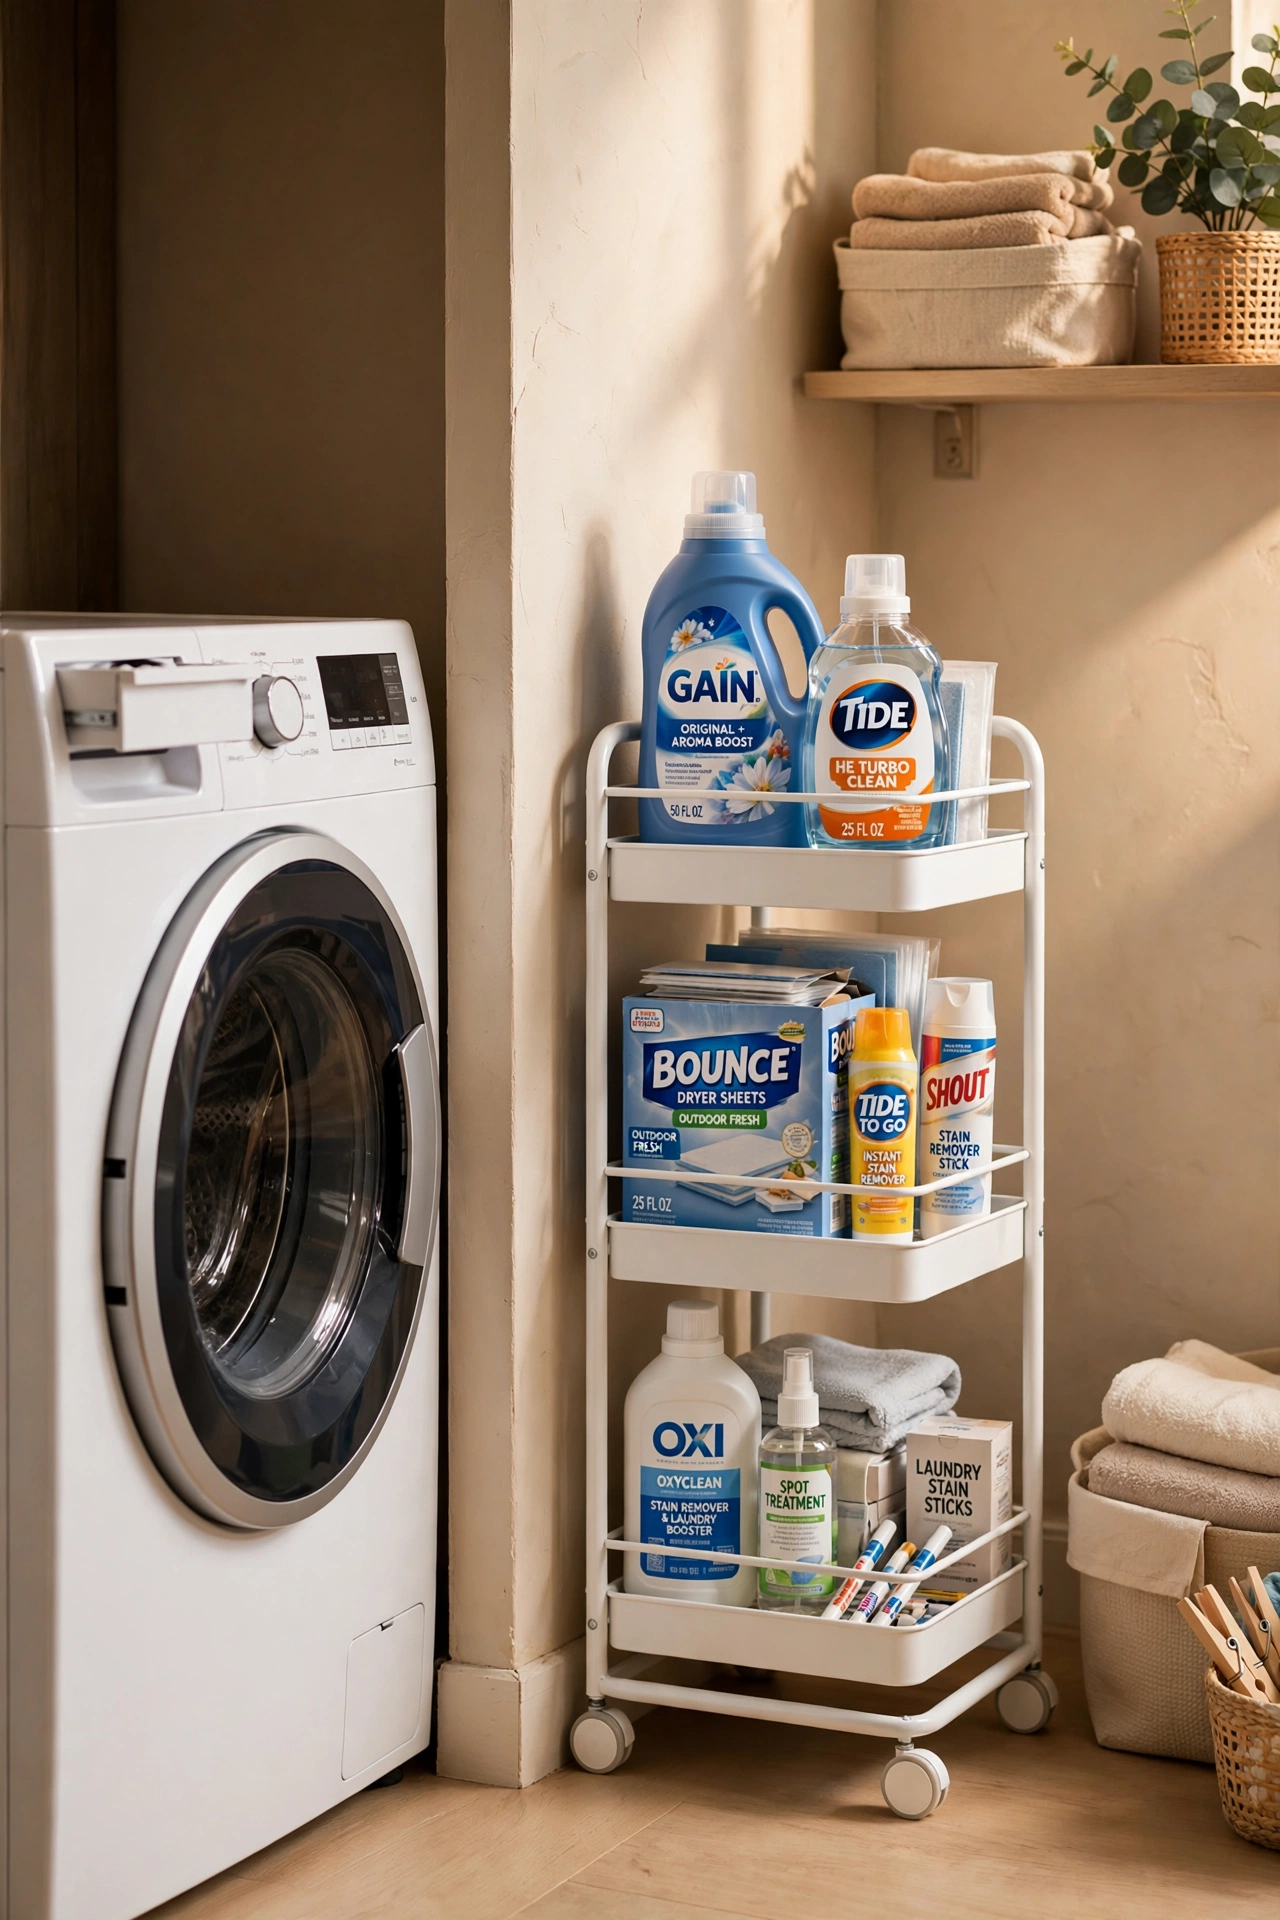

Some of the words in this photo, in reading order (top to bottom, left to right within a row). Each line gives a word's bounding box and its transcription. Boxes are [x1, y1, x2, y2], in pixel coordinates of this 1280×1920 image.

[667, 669, 755, 703] GAIN
[840, 695, 909, 732] TIDE
[680, 723, 735, 735] ORIGINAL
[738, 725, 745, 733] +
[671, 736, 713, 748] AROMA
[715, 736, 754, 748] BOOST
[835, 760, 854, 774] HE
[858, 760, 910, 775] TURBO
[846, 774, 897, 789] CLEAN
[670, 804, 680, 817] 50
[681, 805, 691, 818] FL
[692, 805, 703, 818] OZ
[841, 822, 855, 837] 25
[856, 822, 868, 837] FL
[870, 822, 885, 837] OZ
[652, 1045, 790, 1089] BOUNCE
[926, 1067, 990, 1111] SHOUT
[677, 1091, 717, 1105] DRYER
[720, 1091, 767, 1105] SHEETS
[858, 1093, 907, 1117] TIDE
[678, 1113, 728, 1126] OUTDOOR
[729, 1114, 760, 1126] FRESH
[859, 1118, 880, 1134] TO
[882, 1118, 907, 1134] GO
[631, 1129, 677, 1142] OUTDOOR
[939, 1130, 971, 1143] STAIN
[863, 1150, 902, 1163] INSTANT
[929, 1143, 980, 1157] REMOVER
[867, 1162, 897, 1174] STAIN
[939, 1157, 970, 1170] STICK
[860, 1173, 906, 1185] REMOVER
[632, 1195, 645, 1210] 25
[646, 1196, 658, 1211] FL
[658, 1197, 672, 1212] OZ
[652, 1421, 724, 1458] OXI
[916, 1458, 982, 1481] LAUNDRY
[656, 1474, 722, 1489] OXYCLEAN
[780, 1480, 810, 1495] SPOT
[928, 1478, 969, 1498] STAIN
[650, 1500, 678, 1513] STAIN
[681, 1502, 729, 1513] REMOVER
[765, 1492, 826, 1511] TREATMENT
[924, 1496, 973, 1517] STICKS
[661, 1513, 669, 1523] &
[670, 1513, 717, 1525] LAUNDRY
[666, 1525, 713, 1536] BOOSTER
